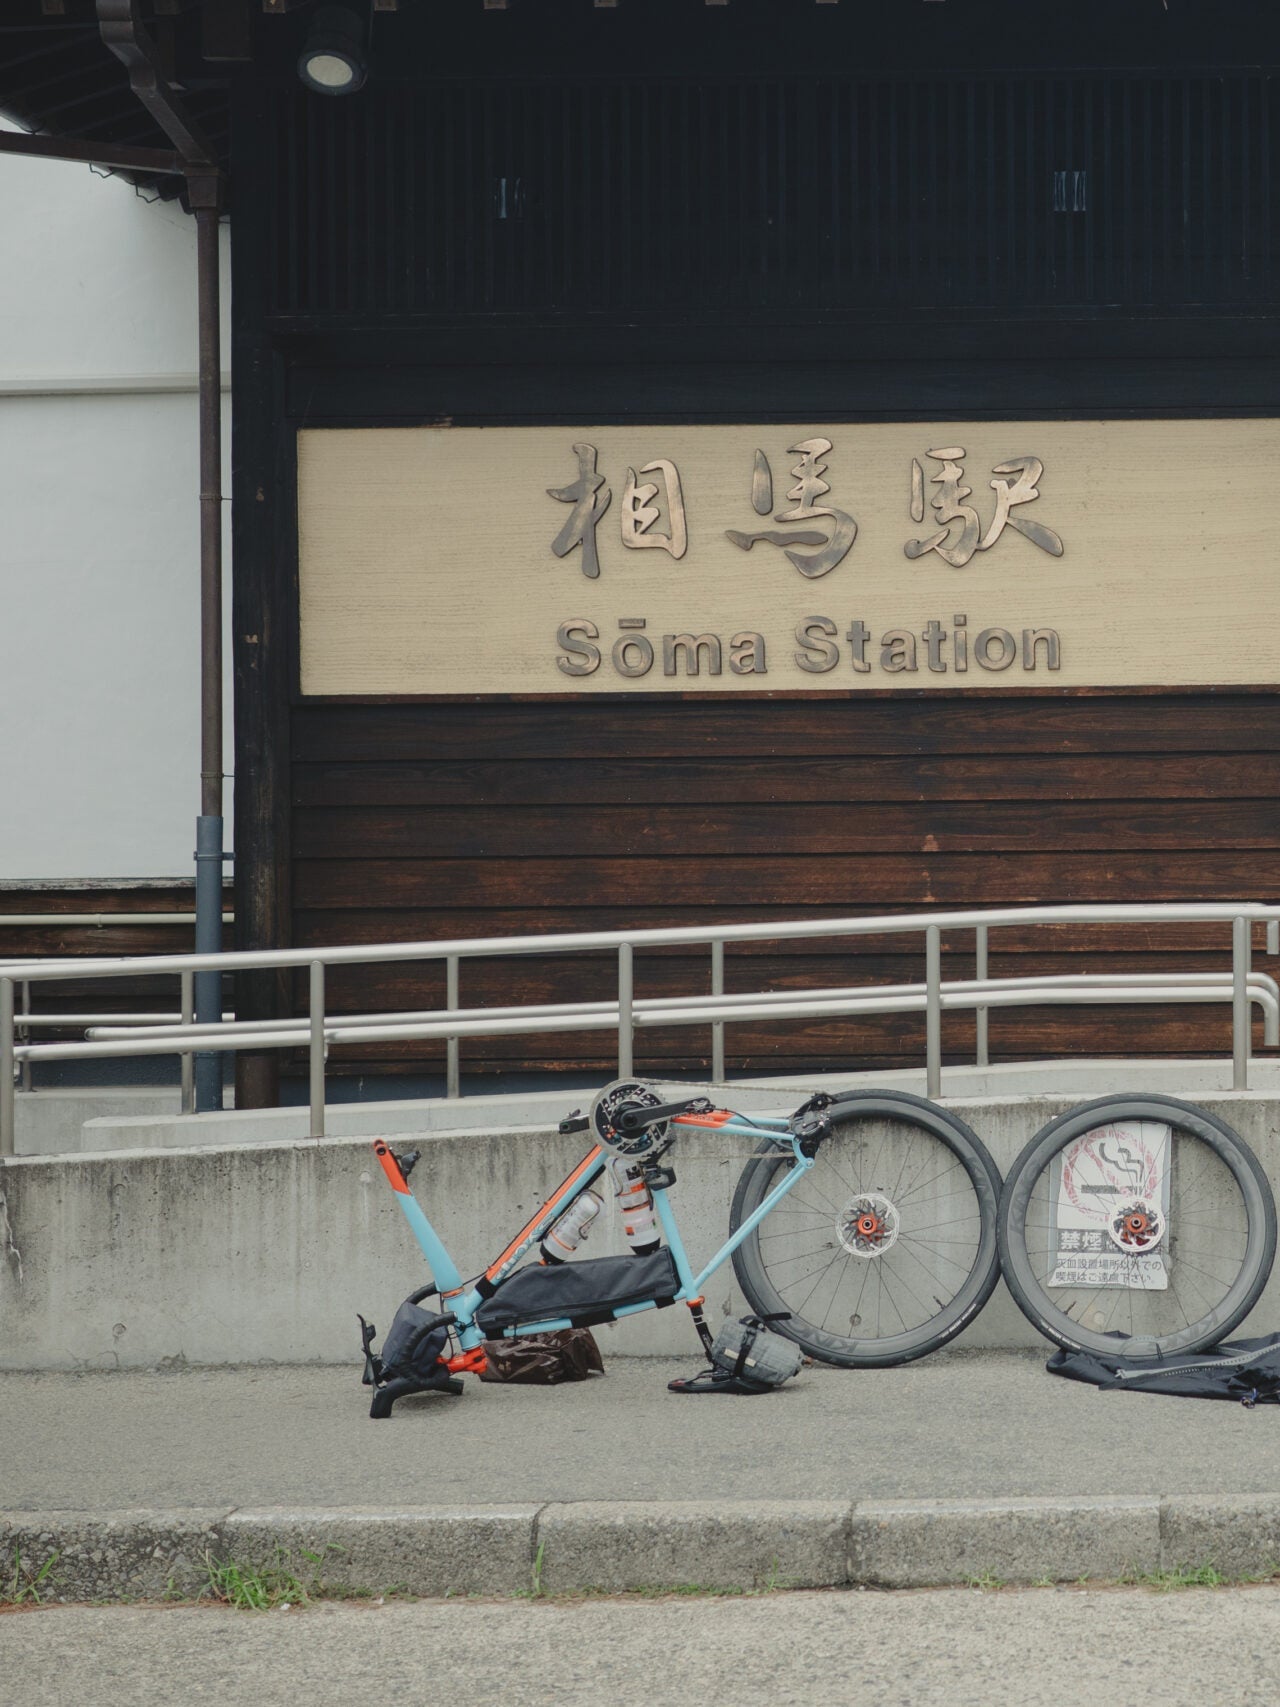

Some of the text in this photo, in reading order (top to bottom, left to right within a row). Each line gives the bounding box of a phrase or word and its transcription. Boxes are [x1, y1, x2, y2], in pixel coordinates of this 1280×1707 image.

[545, 436, 1064, 578] 相馬駅
[555, 613, 1063, 677] Sōma Station
[1060, 1231, 1103, 1251] 禁煙
